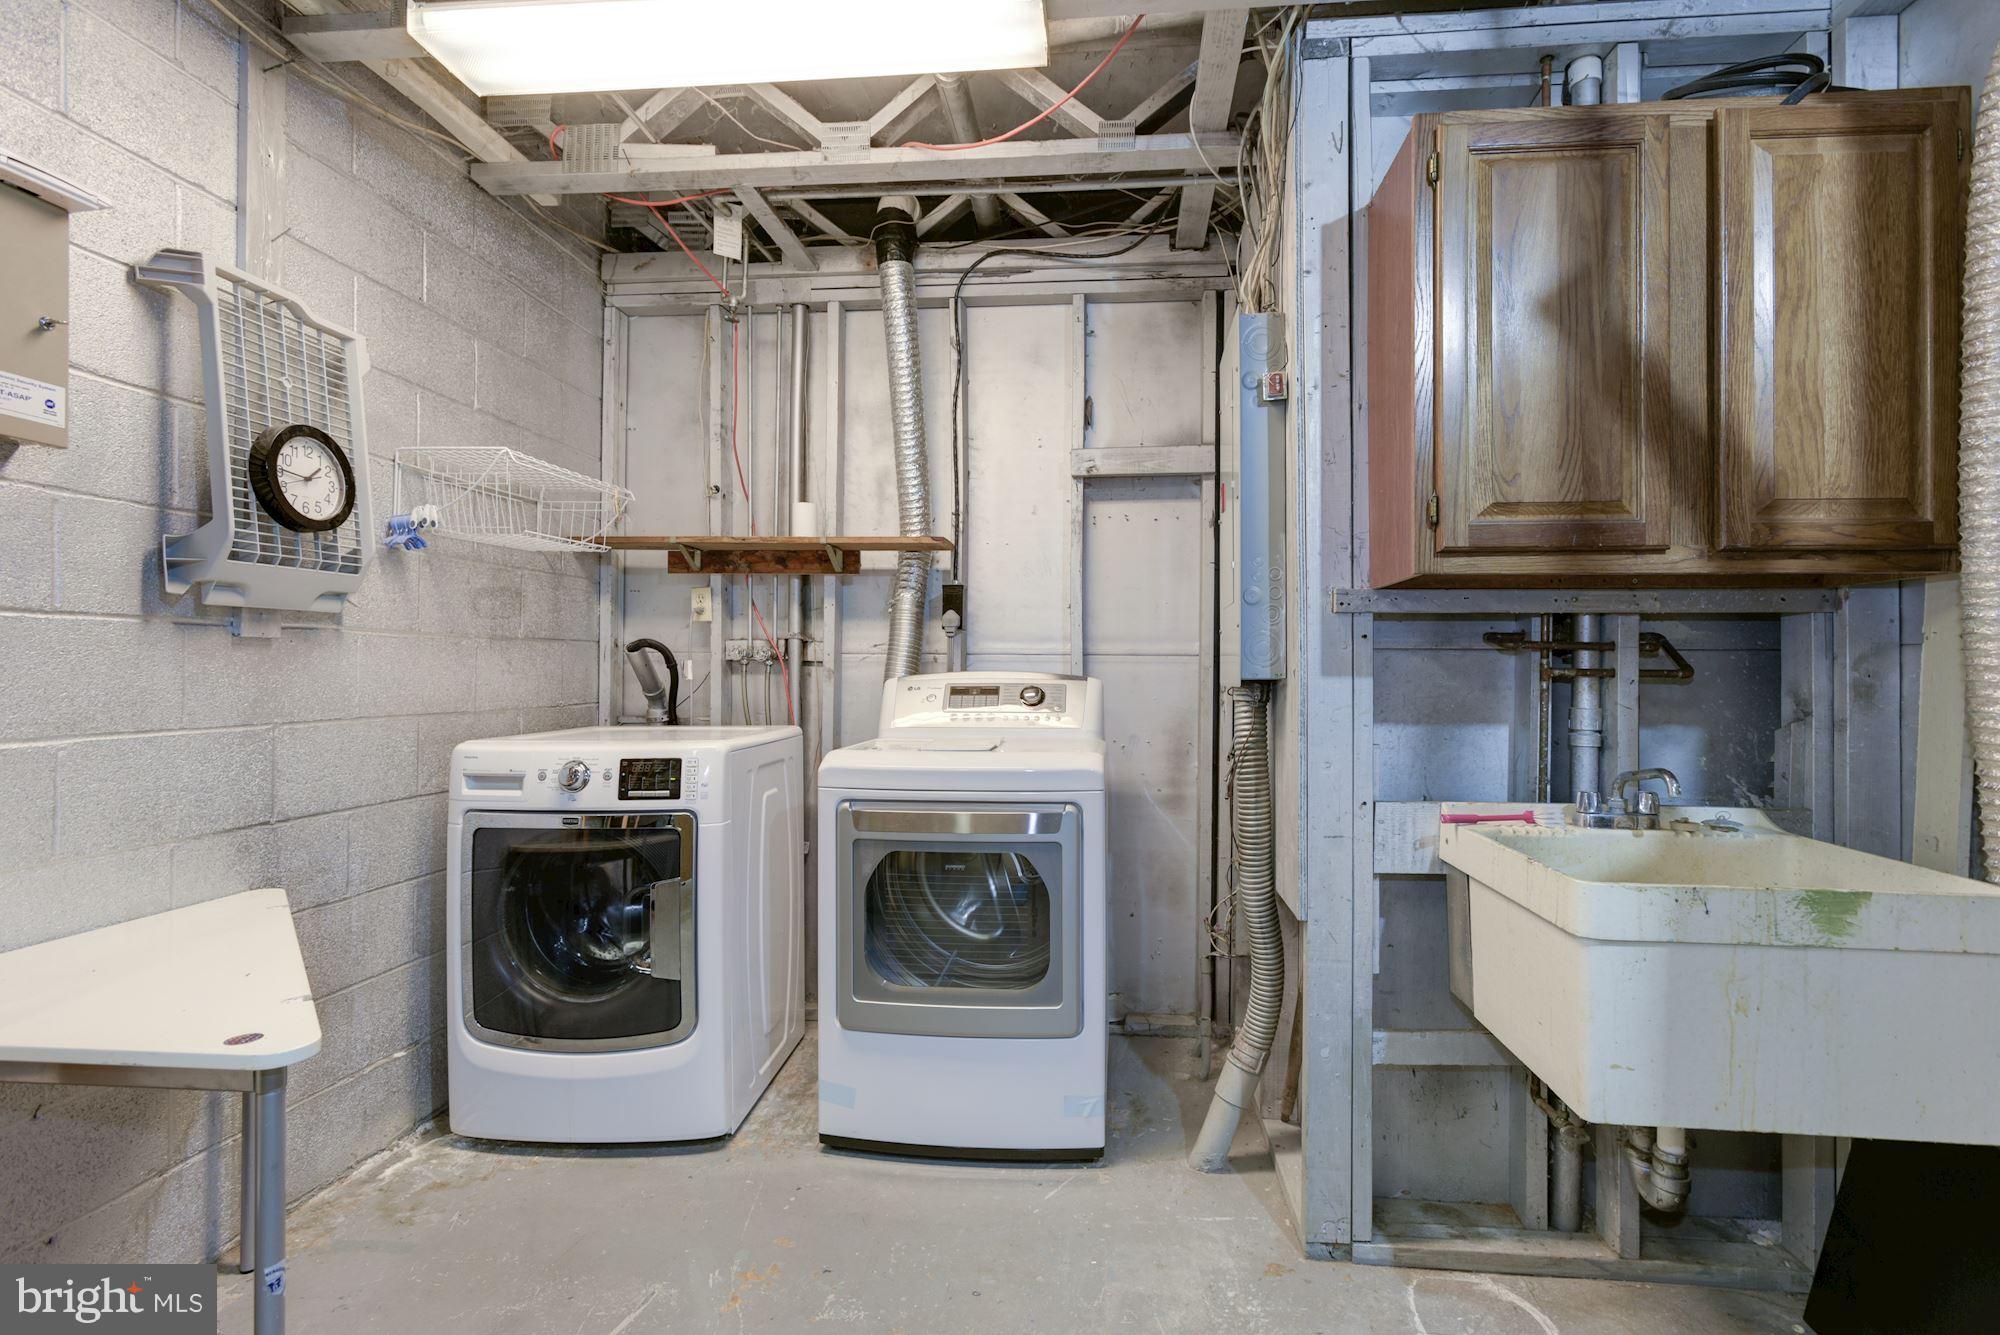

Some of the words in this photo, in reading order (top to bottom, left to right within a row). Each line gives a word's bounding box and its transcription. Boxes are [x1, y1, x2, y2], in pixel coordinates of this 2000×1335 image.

[289, 444, 298, 458] 11
[302, 444, 314, 460] 12
[280, 453, 292, 467] 10
[324, 465, 332, 478] 2
[281, 480, 288, 494] 8
[328, 480, 335, 493] 3
[290, 493, 298, 506] 7
[323, 493, 331, 505] 4
[302, 501, 310, 514] 6
[314, 501, 322, 514] 5
